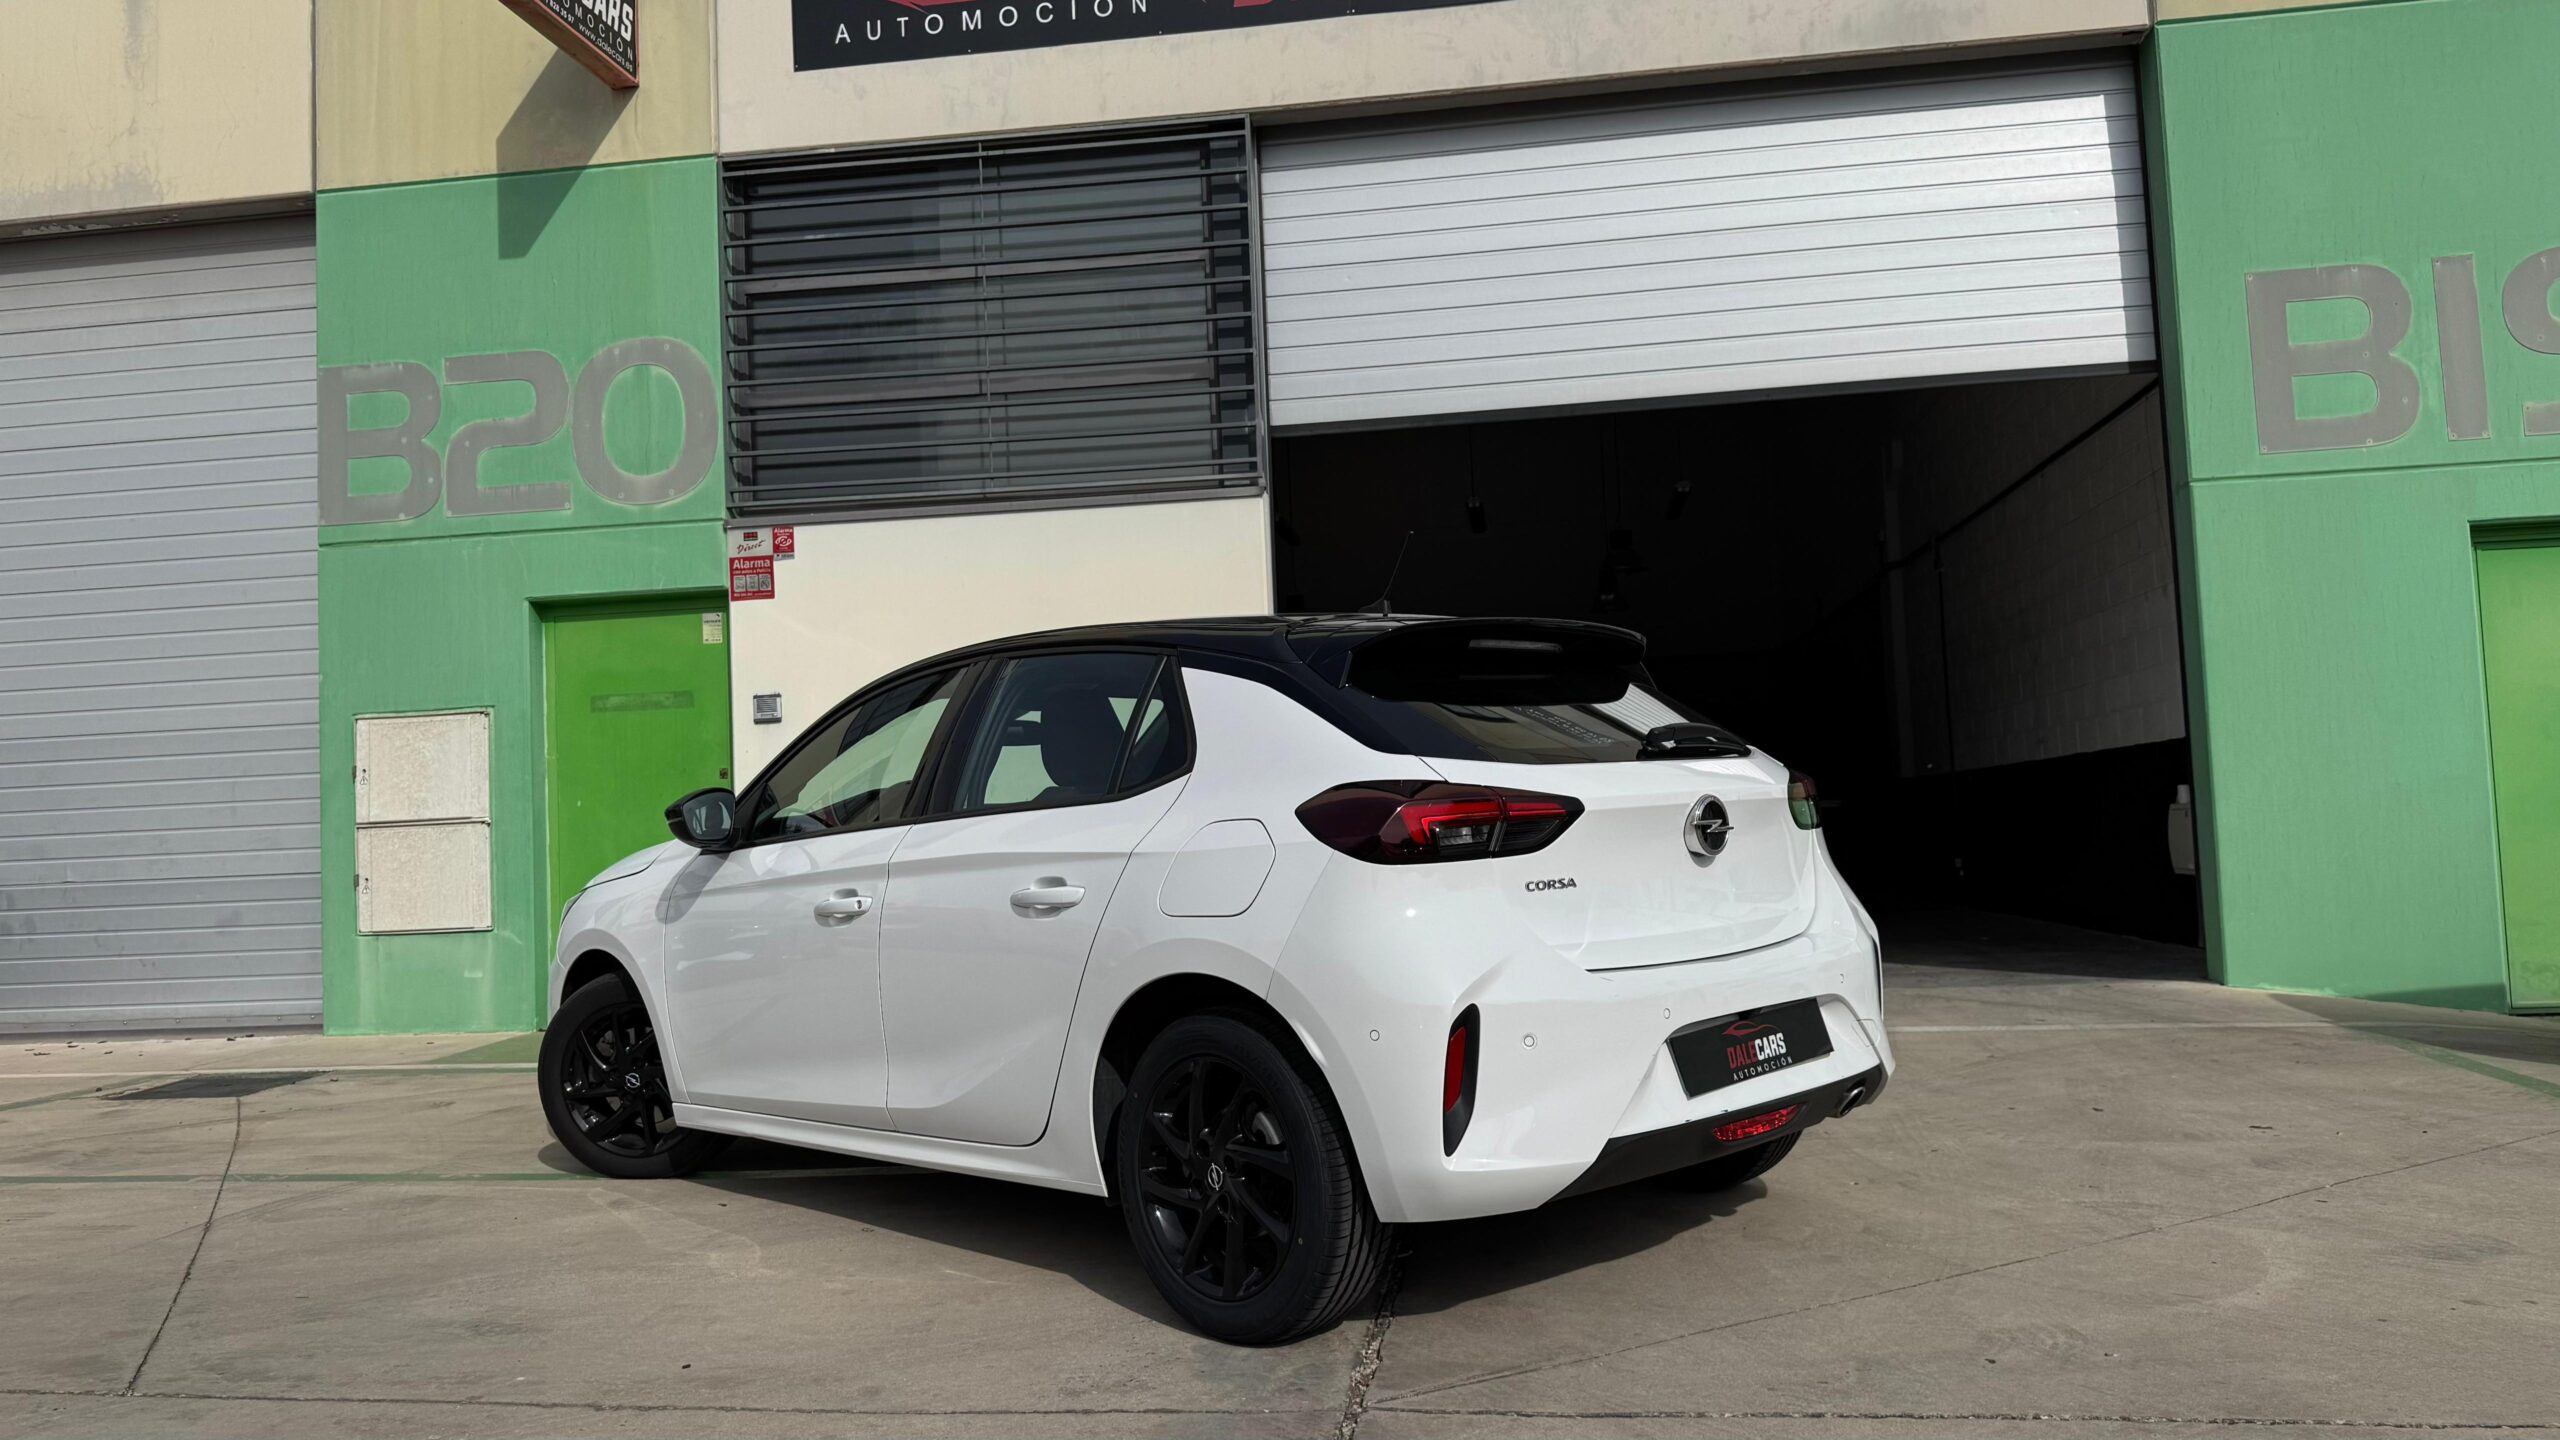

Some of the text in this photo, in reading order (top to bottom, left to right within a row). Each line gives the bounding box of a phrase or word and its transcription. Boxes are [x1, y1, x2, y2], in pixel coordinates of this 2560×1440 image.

[318, 336, 719, 527] B20
[734, 558, 770, 569] Alarma
[1525, 877, 1577, 892] CORSA
[1727, 1032, 1787, 1069] DALECARS
[1733, 1056, 1793, 1081] AUTOMOCIÓN
